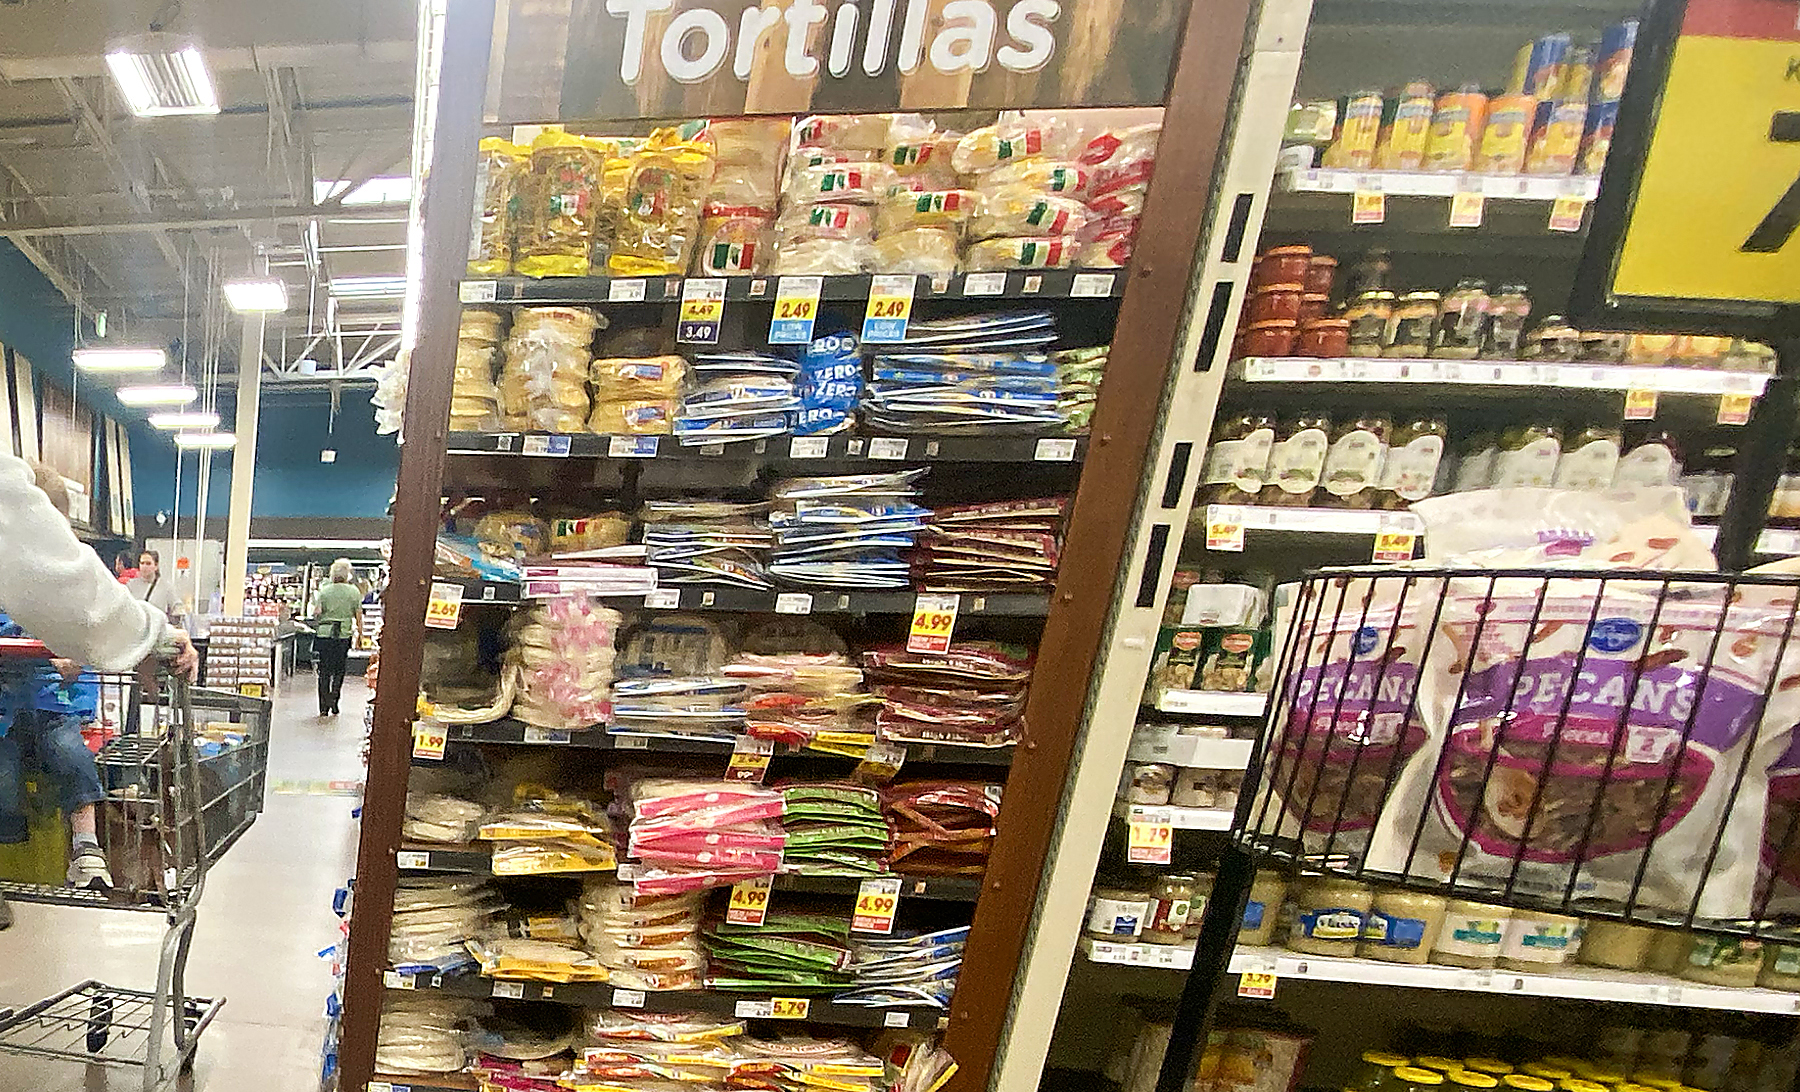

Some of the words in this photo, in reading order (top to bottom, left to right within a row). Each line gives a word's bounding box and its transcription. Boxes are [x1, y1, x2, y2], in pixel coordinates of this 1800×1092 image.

[606, 0, 1062, 85] Tortillas
[780, 302, 811, 318] 2.49
[874, 301, 904, 317] 2.49
[685, 326, 711, 339] 3.49
[814, 364, 856, 379] ZERO
[430, 604, 457, 616] 2.69
[914, 613, 952, 631] 4.99
[1513, 672, 1697, 722] PECANS
[419, 734, 444, 748] 1.99
[1134, 828, 1169, 843] 1.79
[733, 890, 766, 905] 4.99
[857, 897, 894, 913] 4.99
[773, 1001, 806, 1014] 5.79
